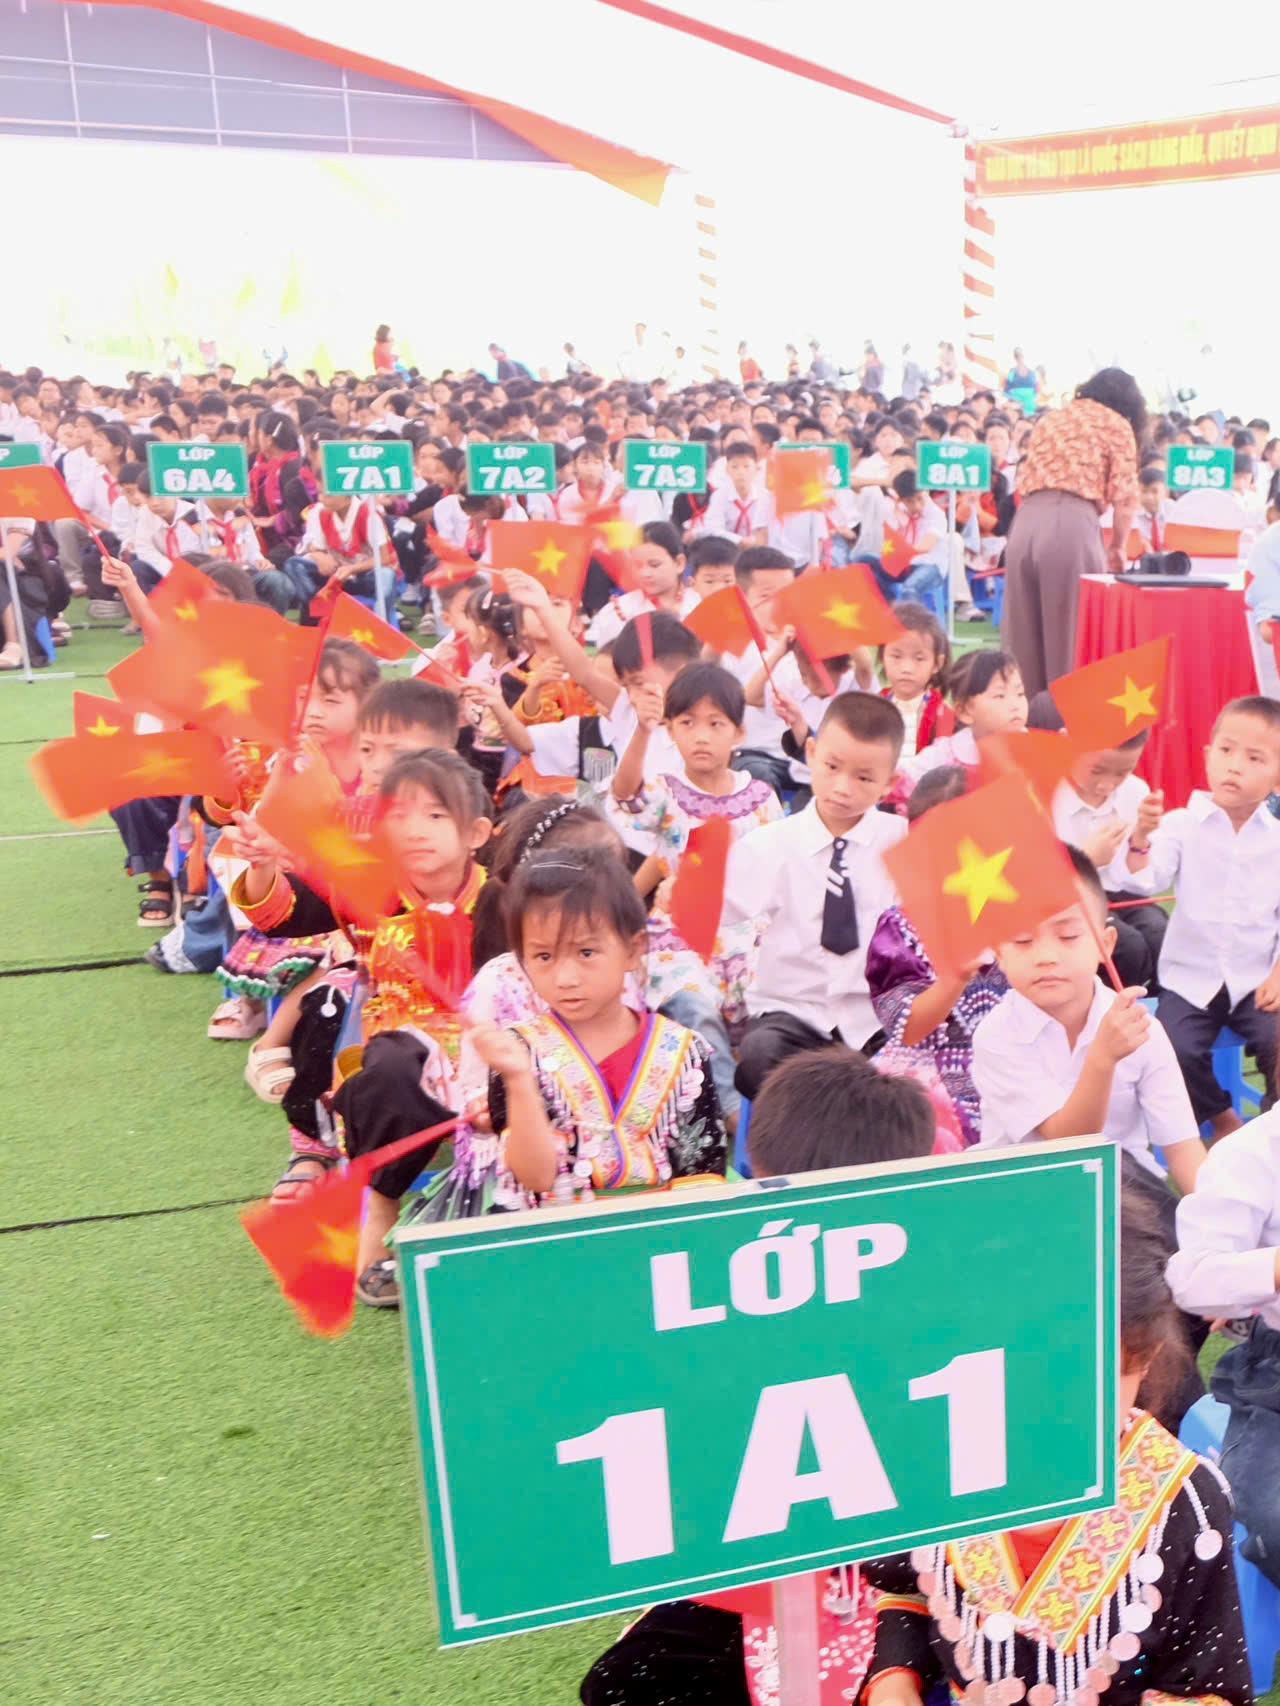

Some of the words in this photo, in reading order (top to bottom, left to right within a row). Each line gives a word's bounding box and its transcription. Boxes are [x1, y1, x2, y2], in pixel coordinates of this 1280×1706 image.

[162, 468, 236, 492] 6A4
[335, 465, 402, 490] 7A1
[478, 465, 547, 490] 7A2
[632, 463, 697, 488] 7A3
[927, 463, 980, 486] 8A1
[650, 1219, 908, 1332] LỚP
[556, 1347, 1007, 1566] 1A1
